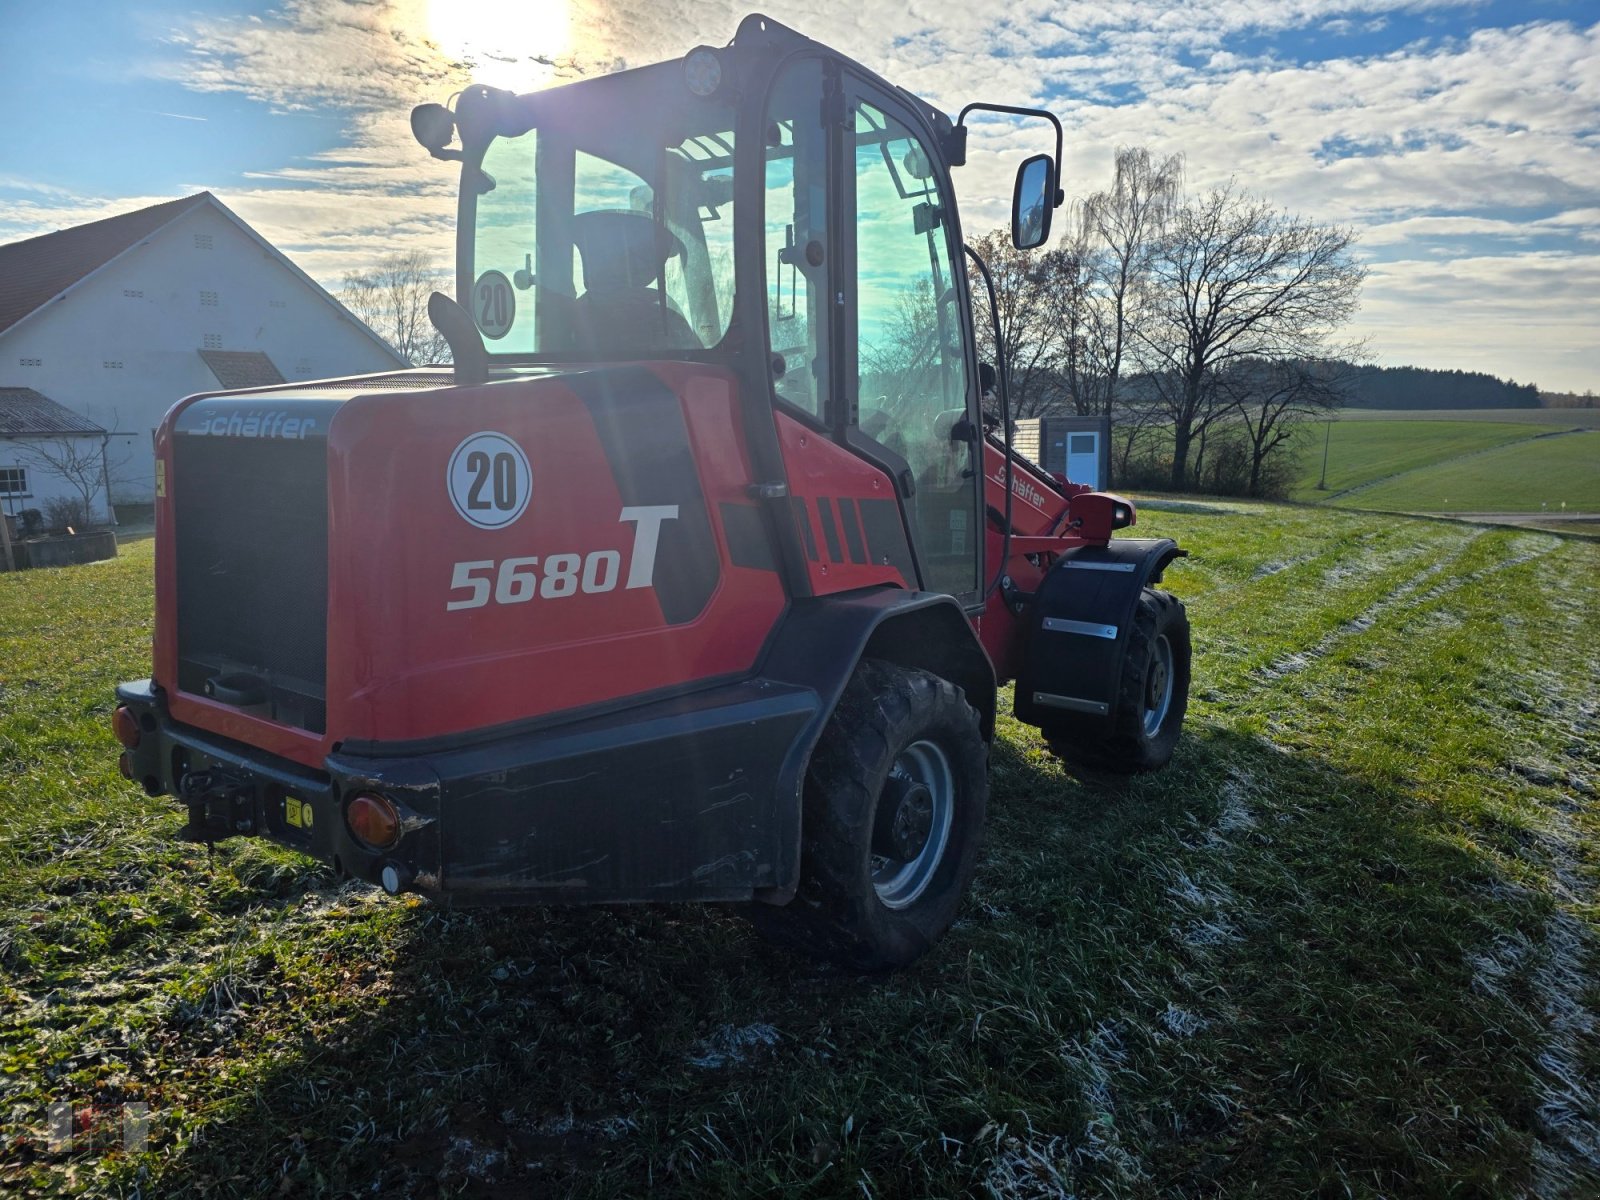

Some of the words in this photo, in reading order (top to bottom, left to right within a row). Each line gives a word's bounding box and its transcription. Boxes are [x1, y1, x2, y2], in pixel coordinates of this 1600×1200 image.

[480, 283, 507, 327] 20
[466, 451, 517, 511] 20
[994, 465, 1045, 507] Shäffer
